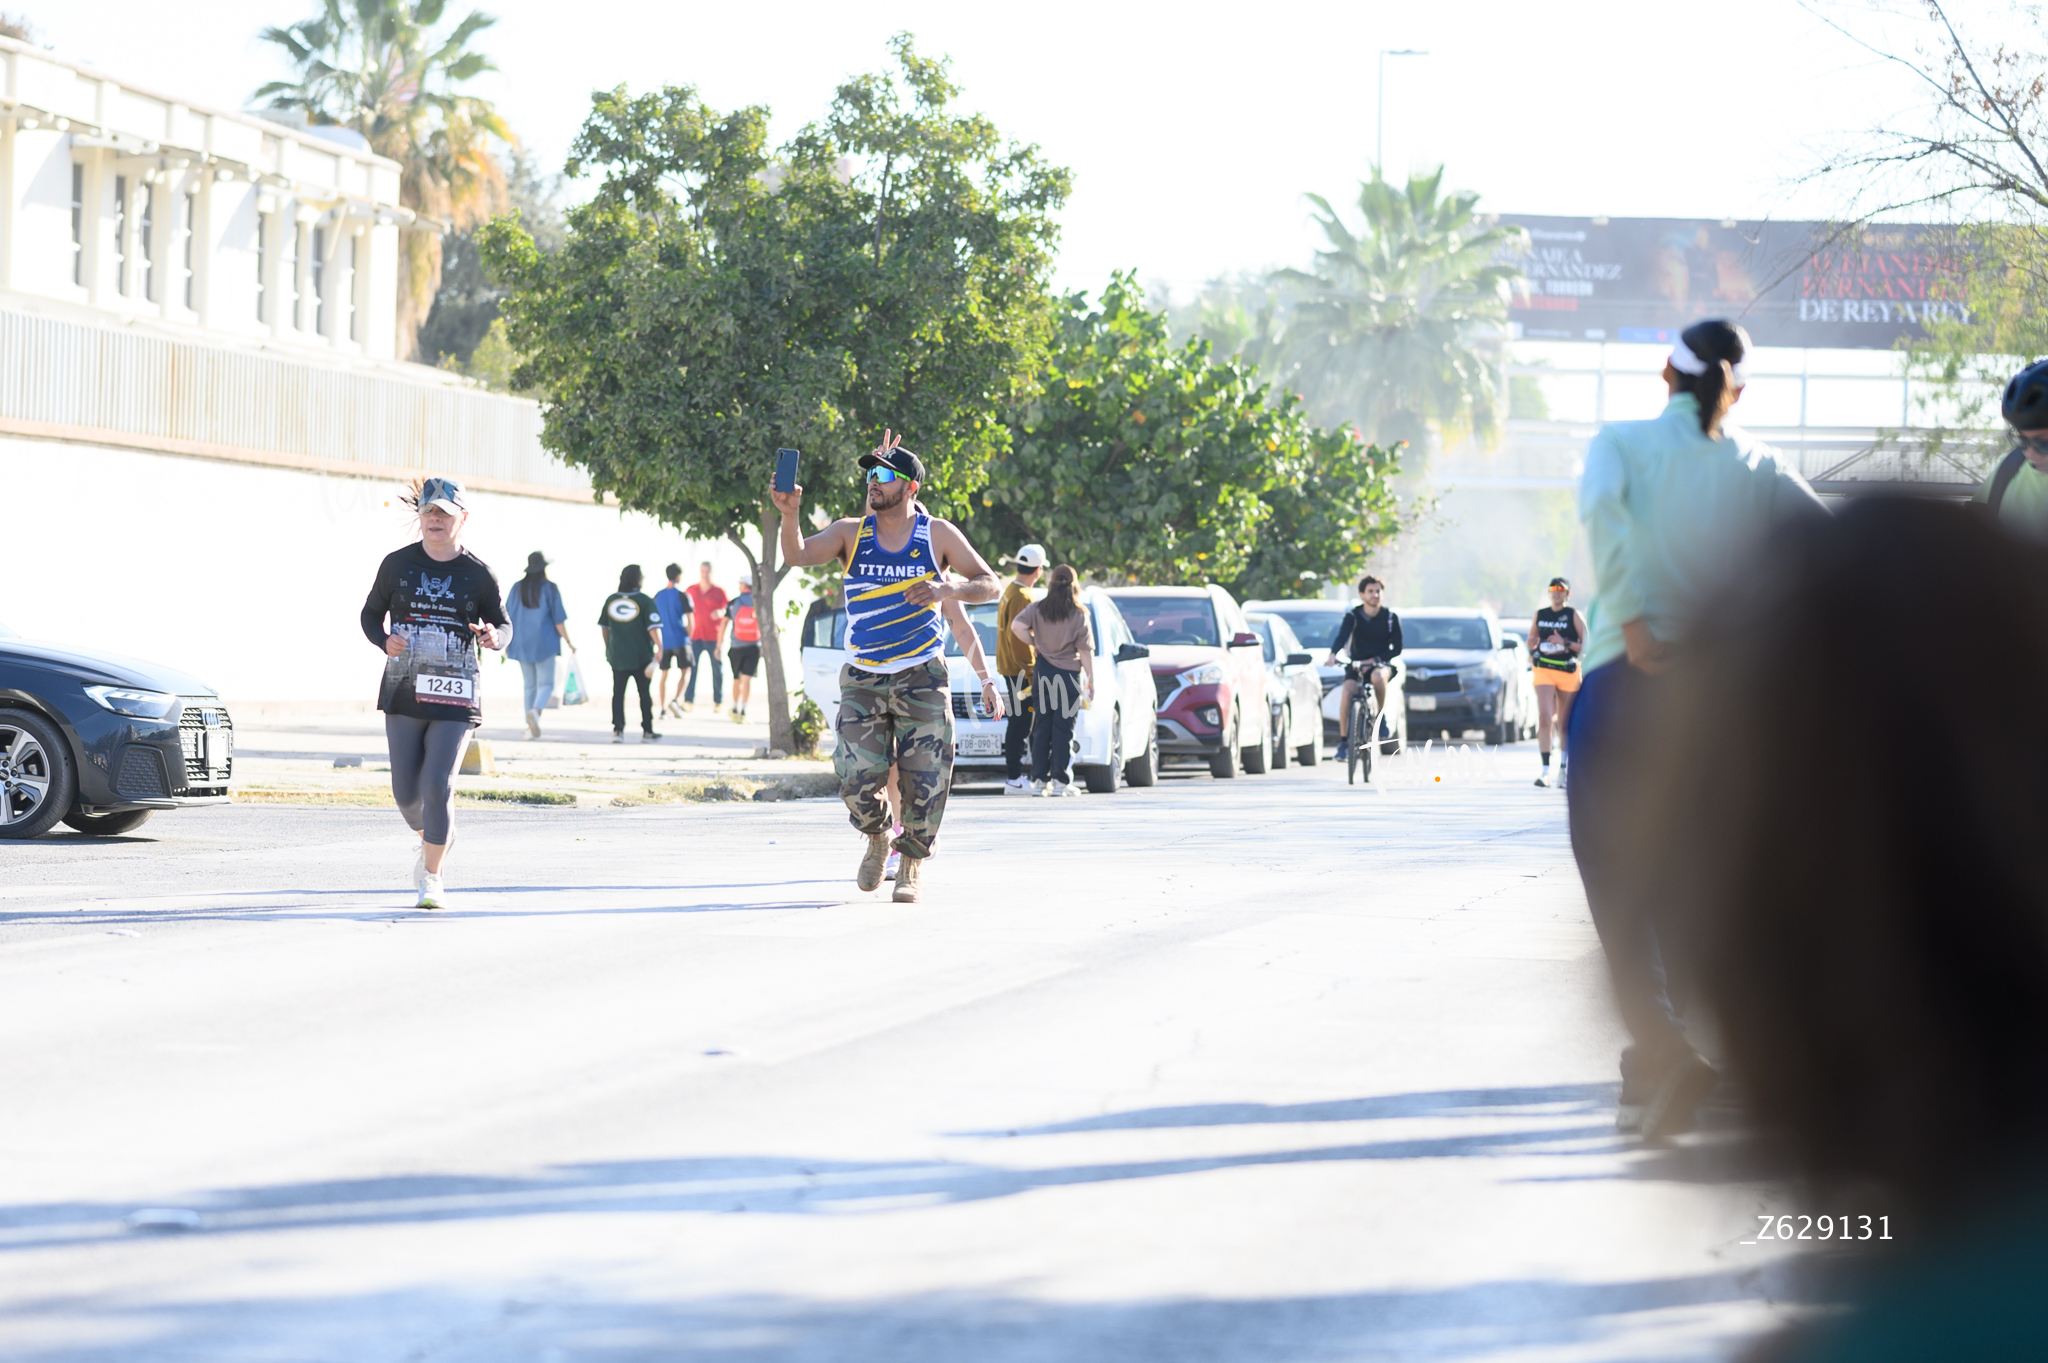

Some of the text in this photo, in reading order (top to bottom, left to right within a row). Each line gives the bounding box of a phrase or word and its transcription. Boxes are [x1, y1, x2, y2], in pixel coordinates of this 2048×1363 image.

[1799, 299, 1838, 323] DE
[1842, 299, 1894, 323] REY
[1895, 300, 1916, 324] A
[858, 563, 926, 577] TITANES
[414, 587, 424, 596] 21
[428, 678, 463, 695] 1243
